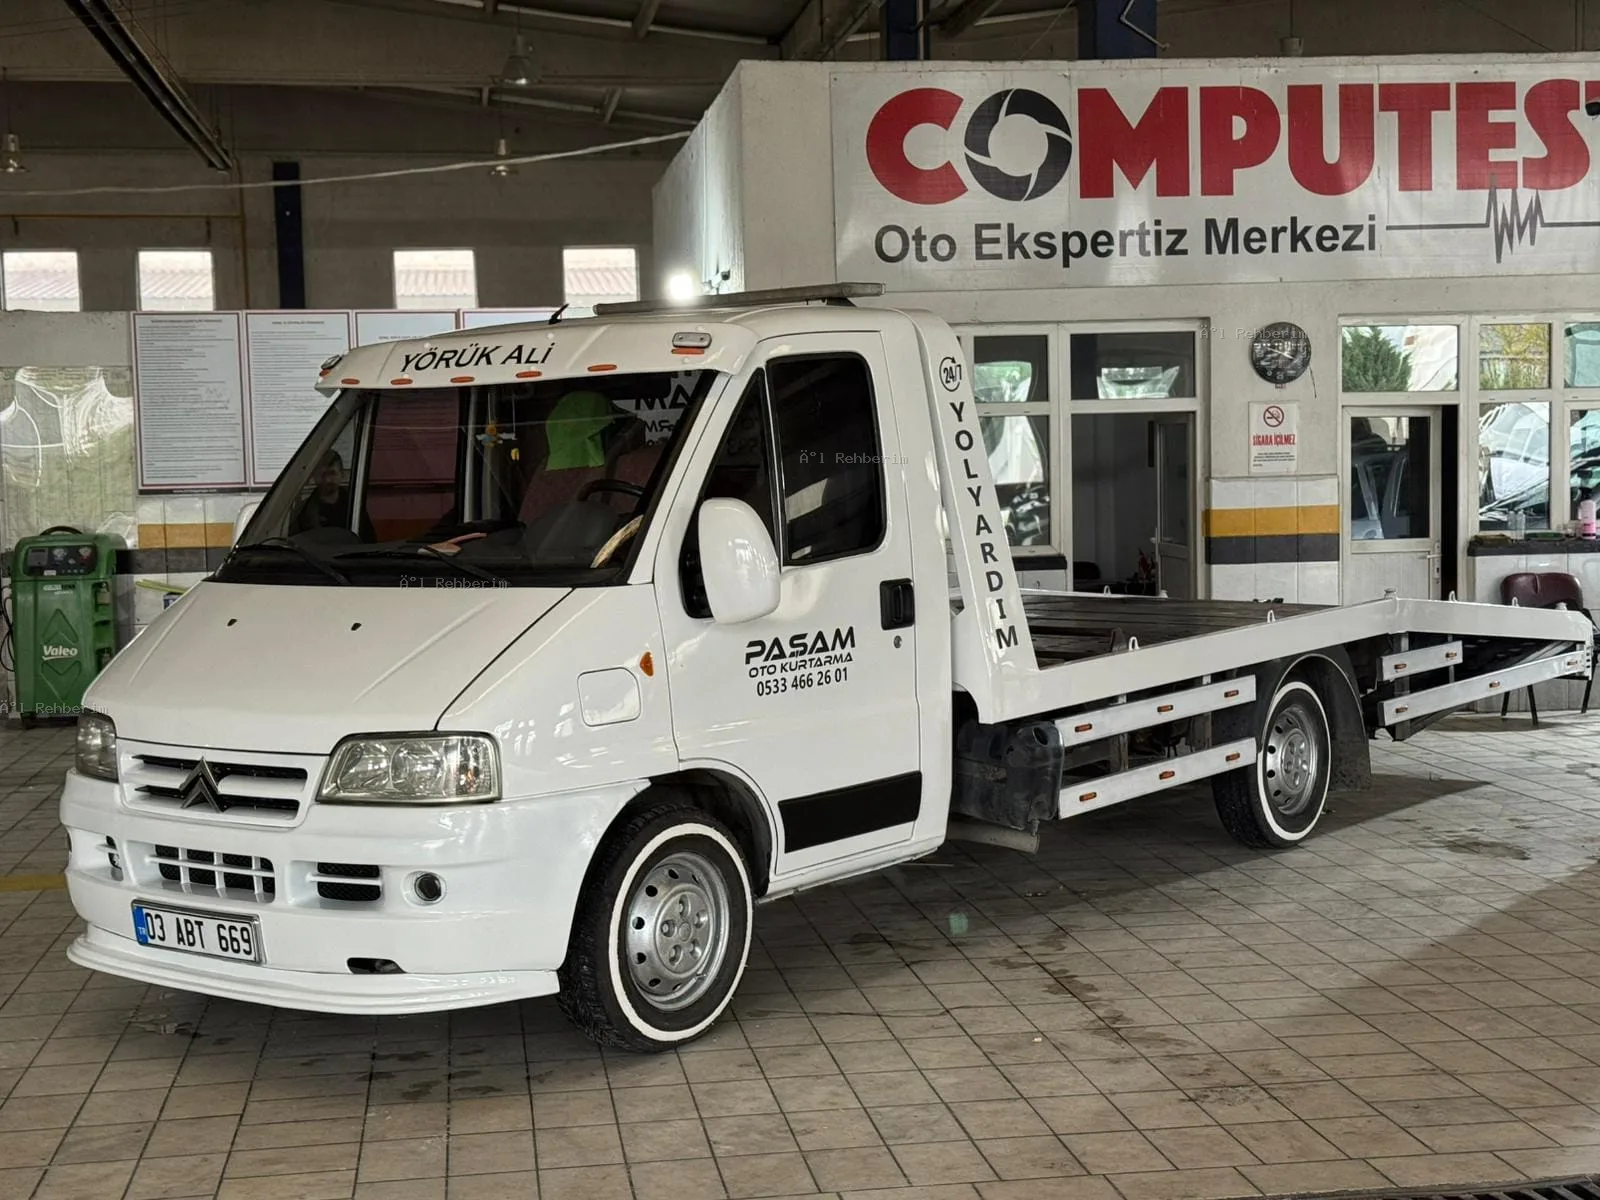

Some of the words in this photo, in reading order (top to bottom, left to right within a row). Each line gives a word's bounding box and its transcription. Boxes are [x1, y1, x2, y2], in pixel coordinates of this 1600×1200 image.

[866, 78, 1600, 205] COMPUTES
[874, 224, 957, 263] Oto
[974, 219, 1188, 268] Ekspertiz
[1204, 215, 1377, 255] Merkezi
[400, 343, 502, 372] YÖRÜK
[501, 342, 555, 364] ALİ
[943, 364, 962, 384] 24/7
[43, 645, 78, 656] Valeo
[749, 664, 777, 678] OTO
[780, 652, 853, 673] KURTARMA
[757, 677, 787, 697] 0533
[791, 673, 813, 690] 466
[817, 669, 832, 686] 26
[834, 666, 848, 683] 01
[145, 912, 166, 942] 03
[176, 917, 205, 949] ABT
[217, 923, 253, 956] 669
